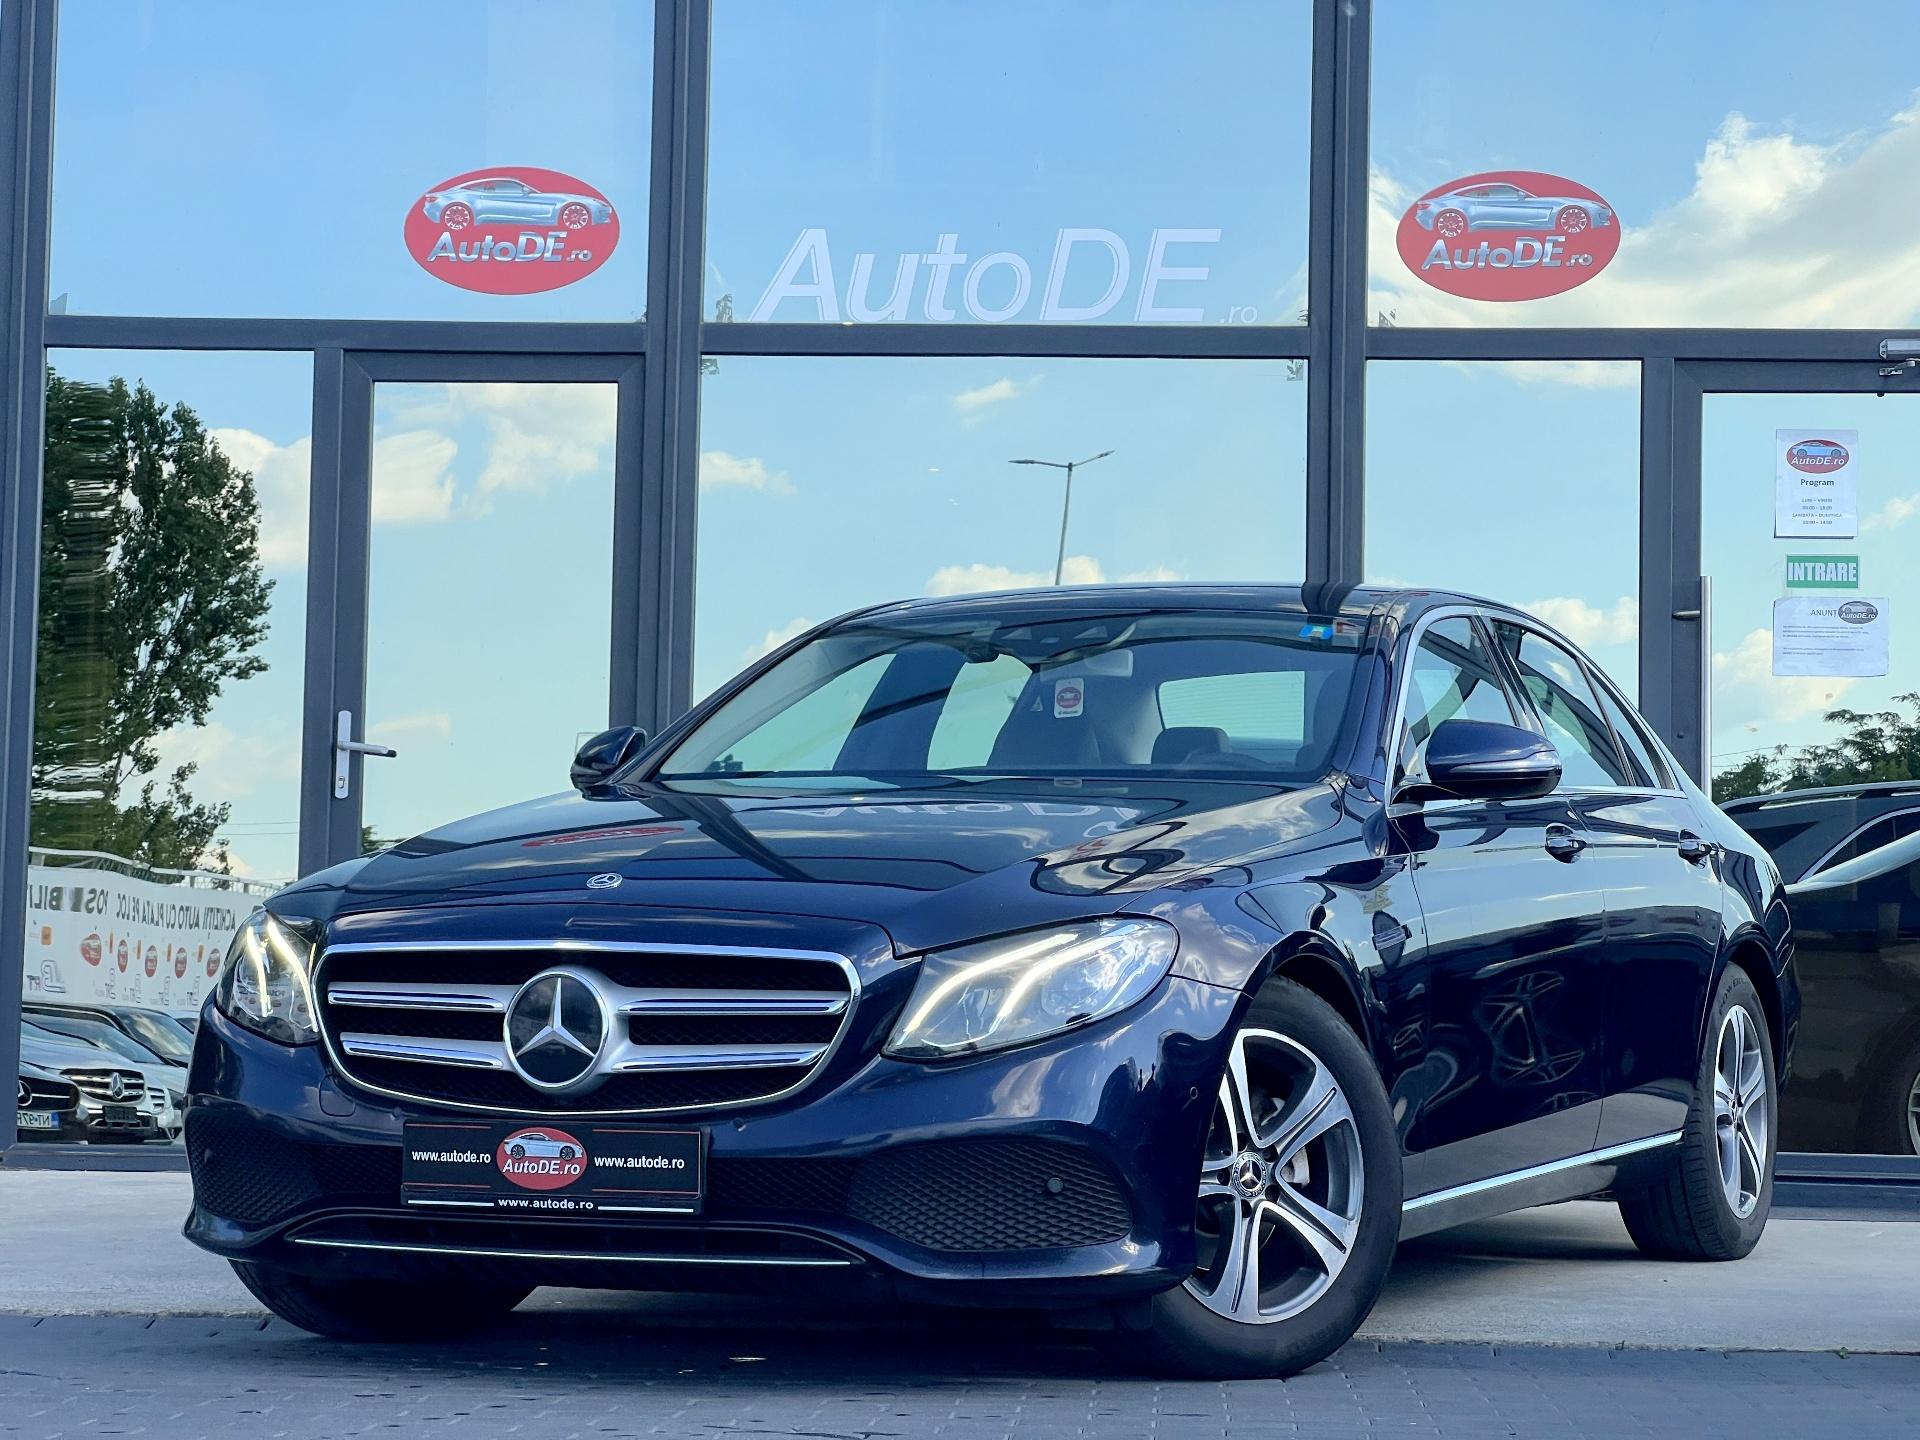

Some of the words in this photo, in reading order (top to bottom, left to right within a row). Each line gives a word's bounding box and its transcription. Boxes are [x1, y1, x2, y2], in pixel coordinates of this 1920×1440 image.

[1790, 455, 1846, 467] AutoDE.ro
[1800, 478, 1835, 488] Program
[1787, 562, 1857, 582] INTRARE
[412, 1149, 491, 1163] www.autode.ro
[594, 1155, 685, 1169] www.autode.ro
[502, 1158, 581, 1176] AutoDE.ro
[498, 1198, 594, 1210] www.autode.ro
